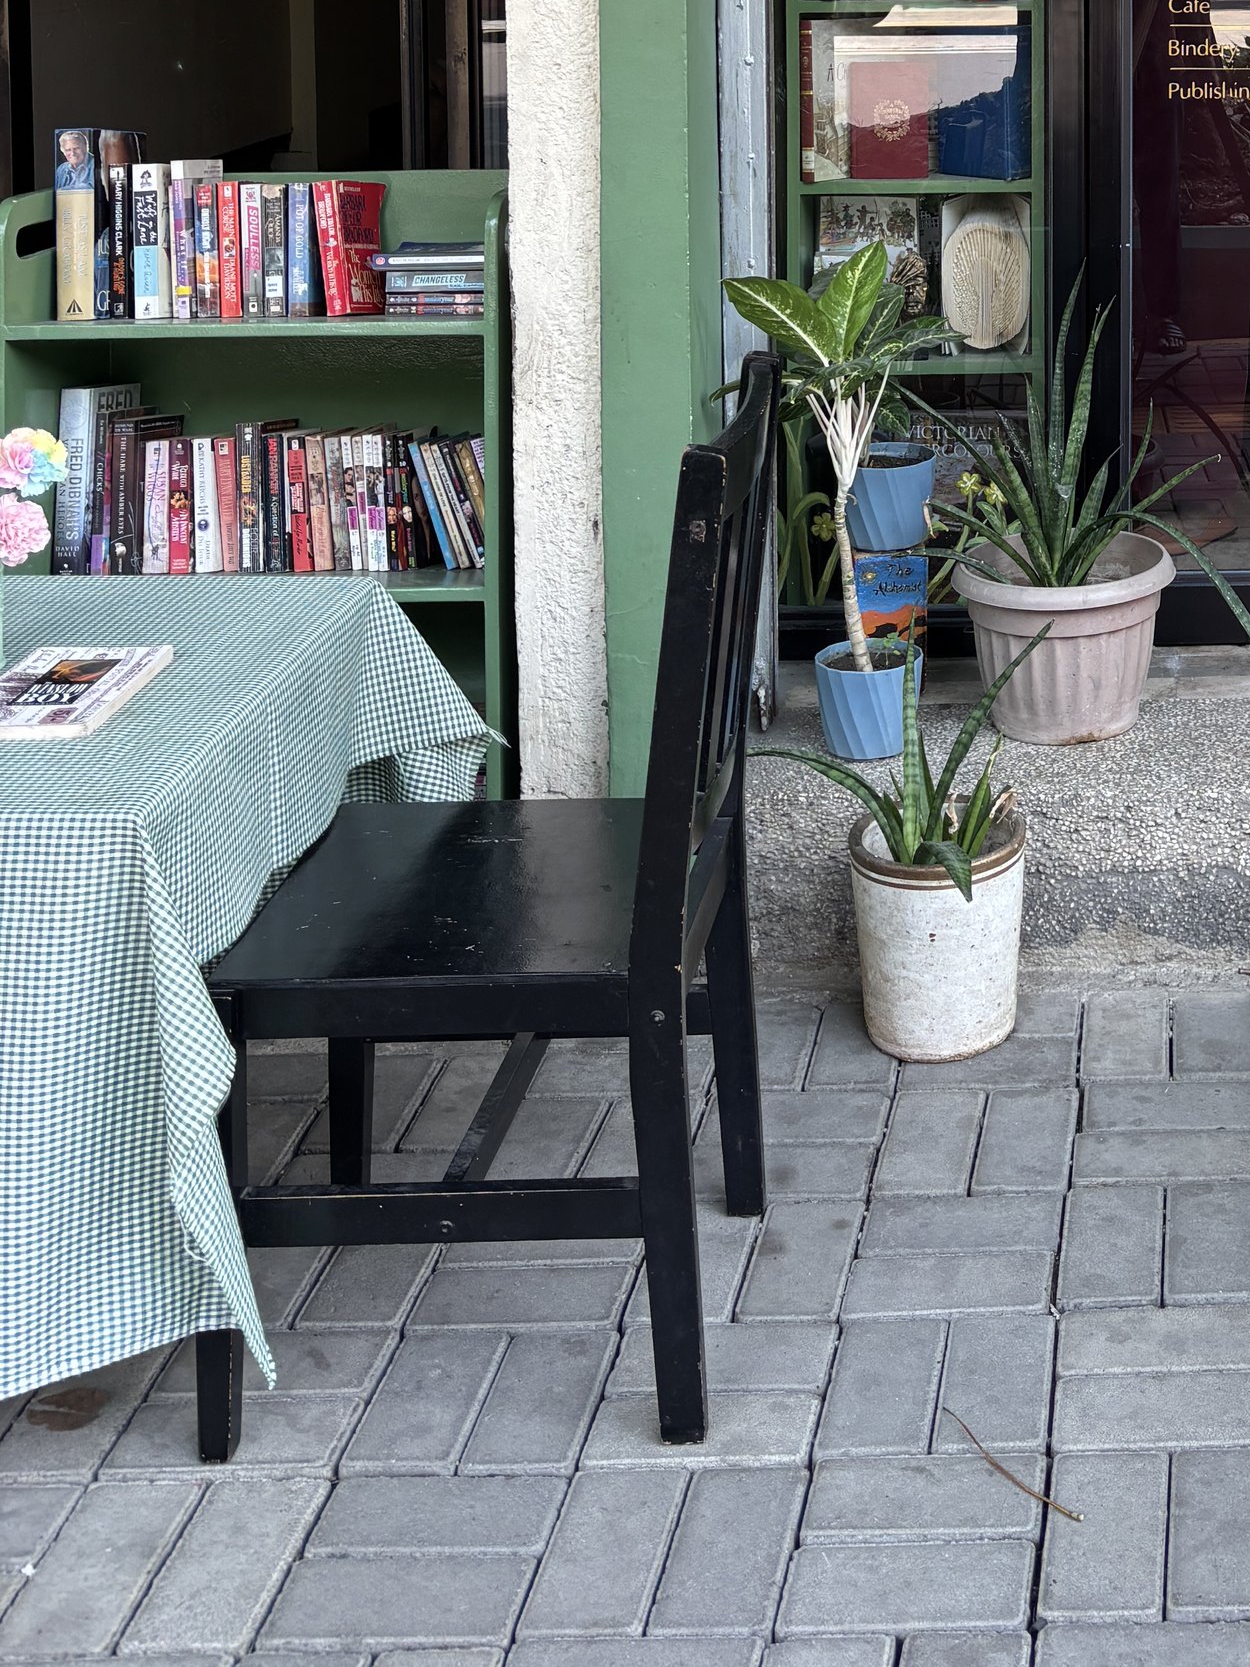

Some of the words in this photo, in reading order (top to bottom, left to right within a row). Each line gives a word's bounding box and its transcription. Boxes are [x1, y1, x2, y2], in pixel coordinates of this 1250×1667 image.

[1168, 39, 1238, 63] Bindery
[115, 180, 123, 201] MARY
[115, 201, 123, 230] HIGGINS
[146, 194, 157, 218] Wife
[296, 204, 304, 221] POT
[249, 209, 259, 268] SOULLESS
[296, 222, 304, 233] OF
[115, 231, 123, 256] CLARK
[295, 235, 304, 259] GOLD
[415, 275, 464, 285] CHANGELESS
[98, 388, 133, 412] FRED
[69, 438, 84, 471] FRED
[268, 438, 278, 456] IAN
[156, 471, 166, 502] SUSAN
[66, 477, 82, 540] DIBNAH'S
[887, 563, 913, 577] The
[16, 693, 74, 704] BOY
